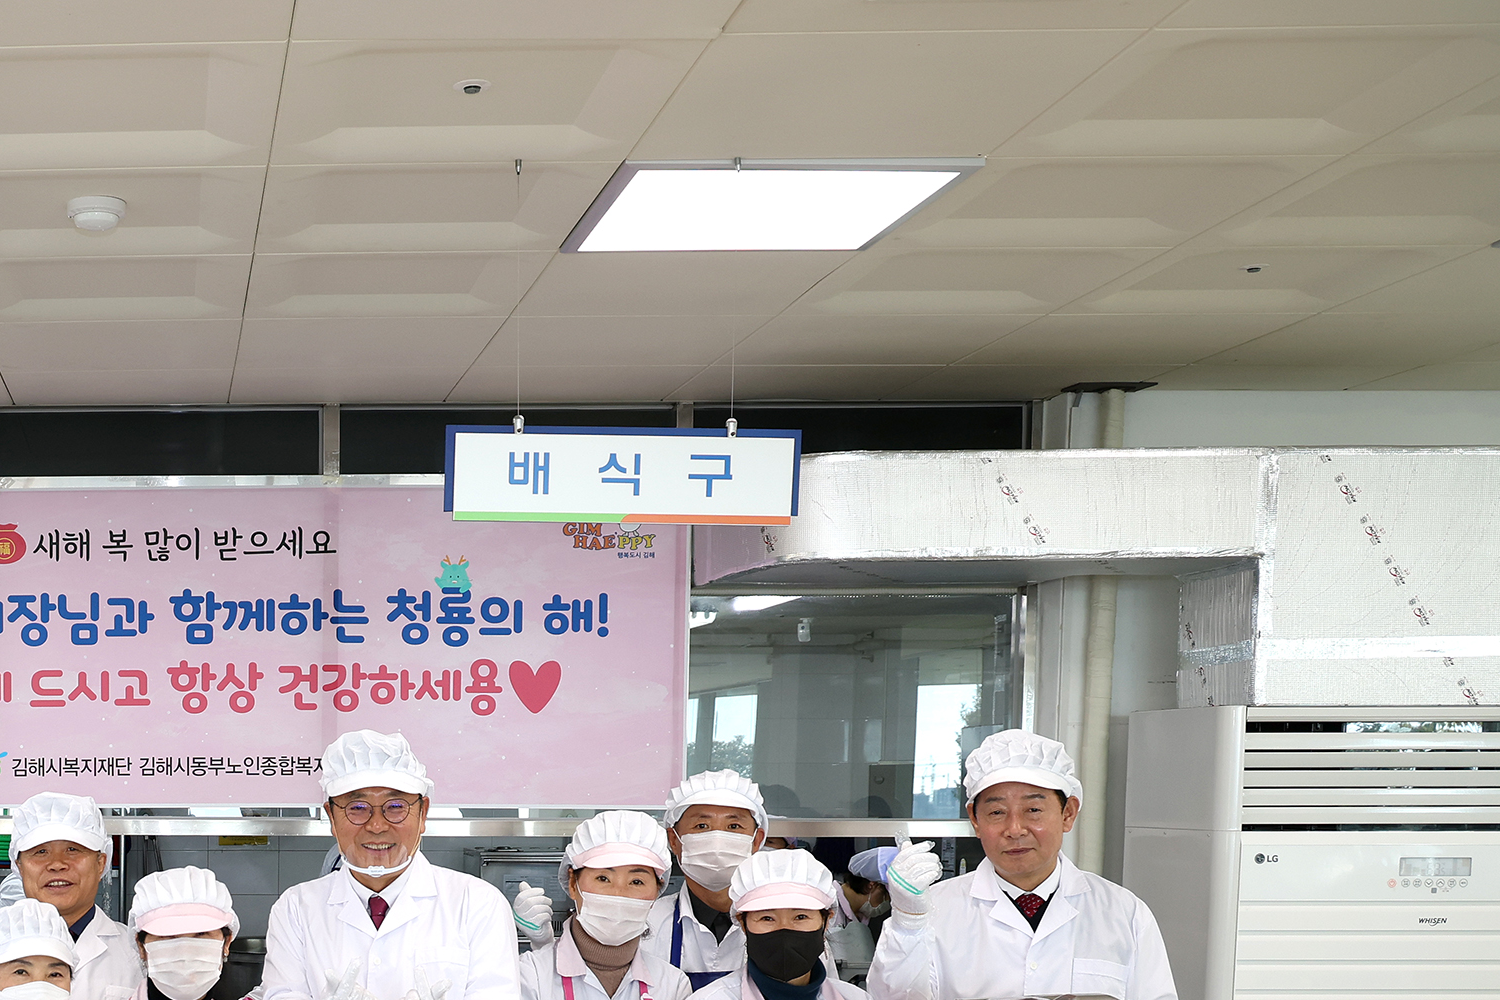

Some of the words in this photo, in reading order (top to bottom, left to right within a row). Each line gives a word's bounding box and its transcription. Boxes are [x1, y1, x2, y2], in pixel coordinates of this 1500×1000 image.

[32, 528, 91, 562] 새해
[102, 528, 134, 563] 복
[143, 526, 201, 562] 많이
[213, 526, 338, 561] 받으세요
[169, 588, 369, 645] 함께하는
[386, 587, 524, 648] 청룡의
[542, 592, 610, 638] 해!
[29, 669, 152, 708] 드시고
[167, 660, 265, 715] 항상
[278, 658, 504, 717] 건강하세용
[11, 756, 133, 777] 김해시복지재단
[1266, 854, 1279, 863] LG
[1418, 917, 1448, 927] WHISEN
